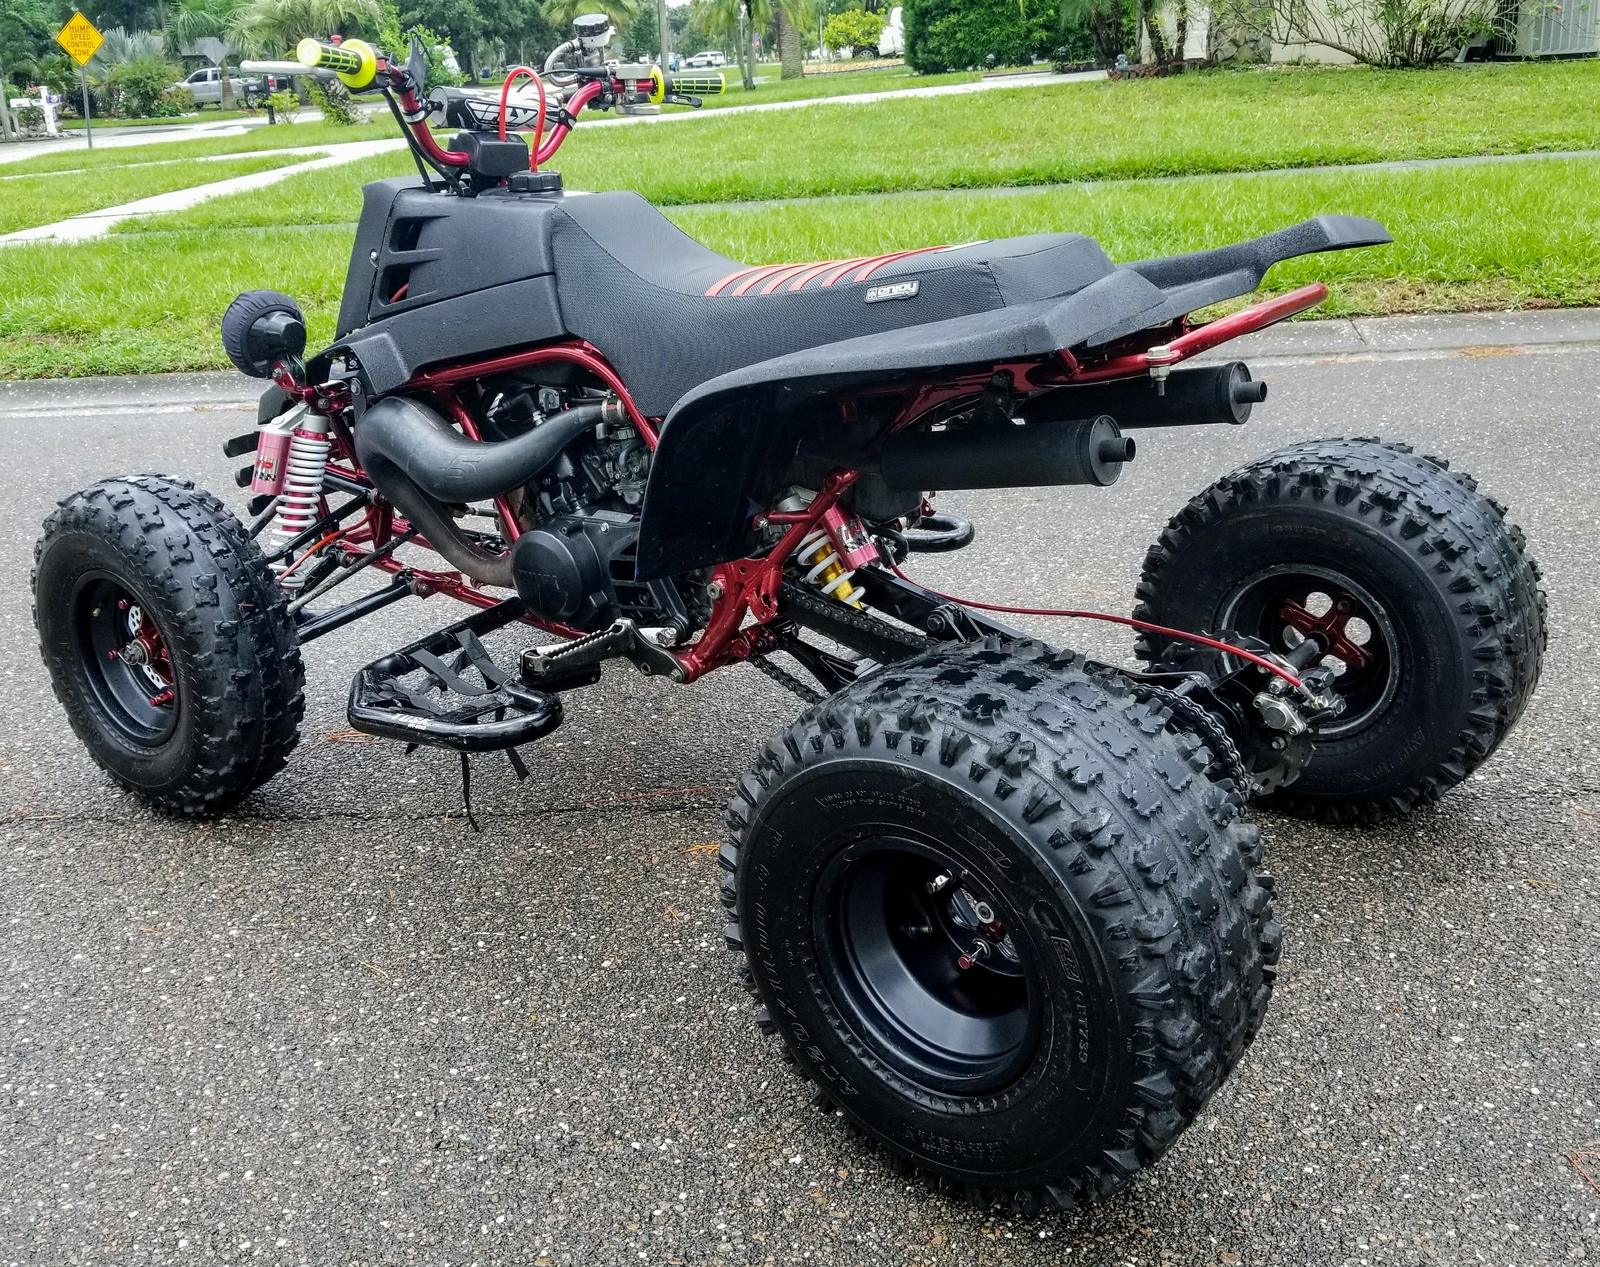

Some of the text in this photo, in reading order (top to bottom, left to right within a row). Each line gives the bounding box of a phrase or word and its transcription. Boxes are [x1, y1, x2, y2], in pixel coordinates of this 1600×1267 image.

[69, 33, 91, 41] SPEED
[66, 41, 96, 49] CONTROL
[73, 49, 91, 57] ZONE
[467, 101, 539, 125] FLY
[878, 282, 917, 295] enjoy
